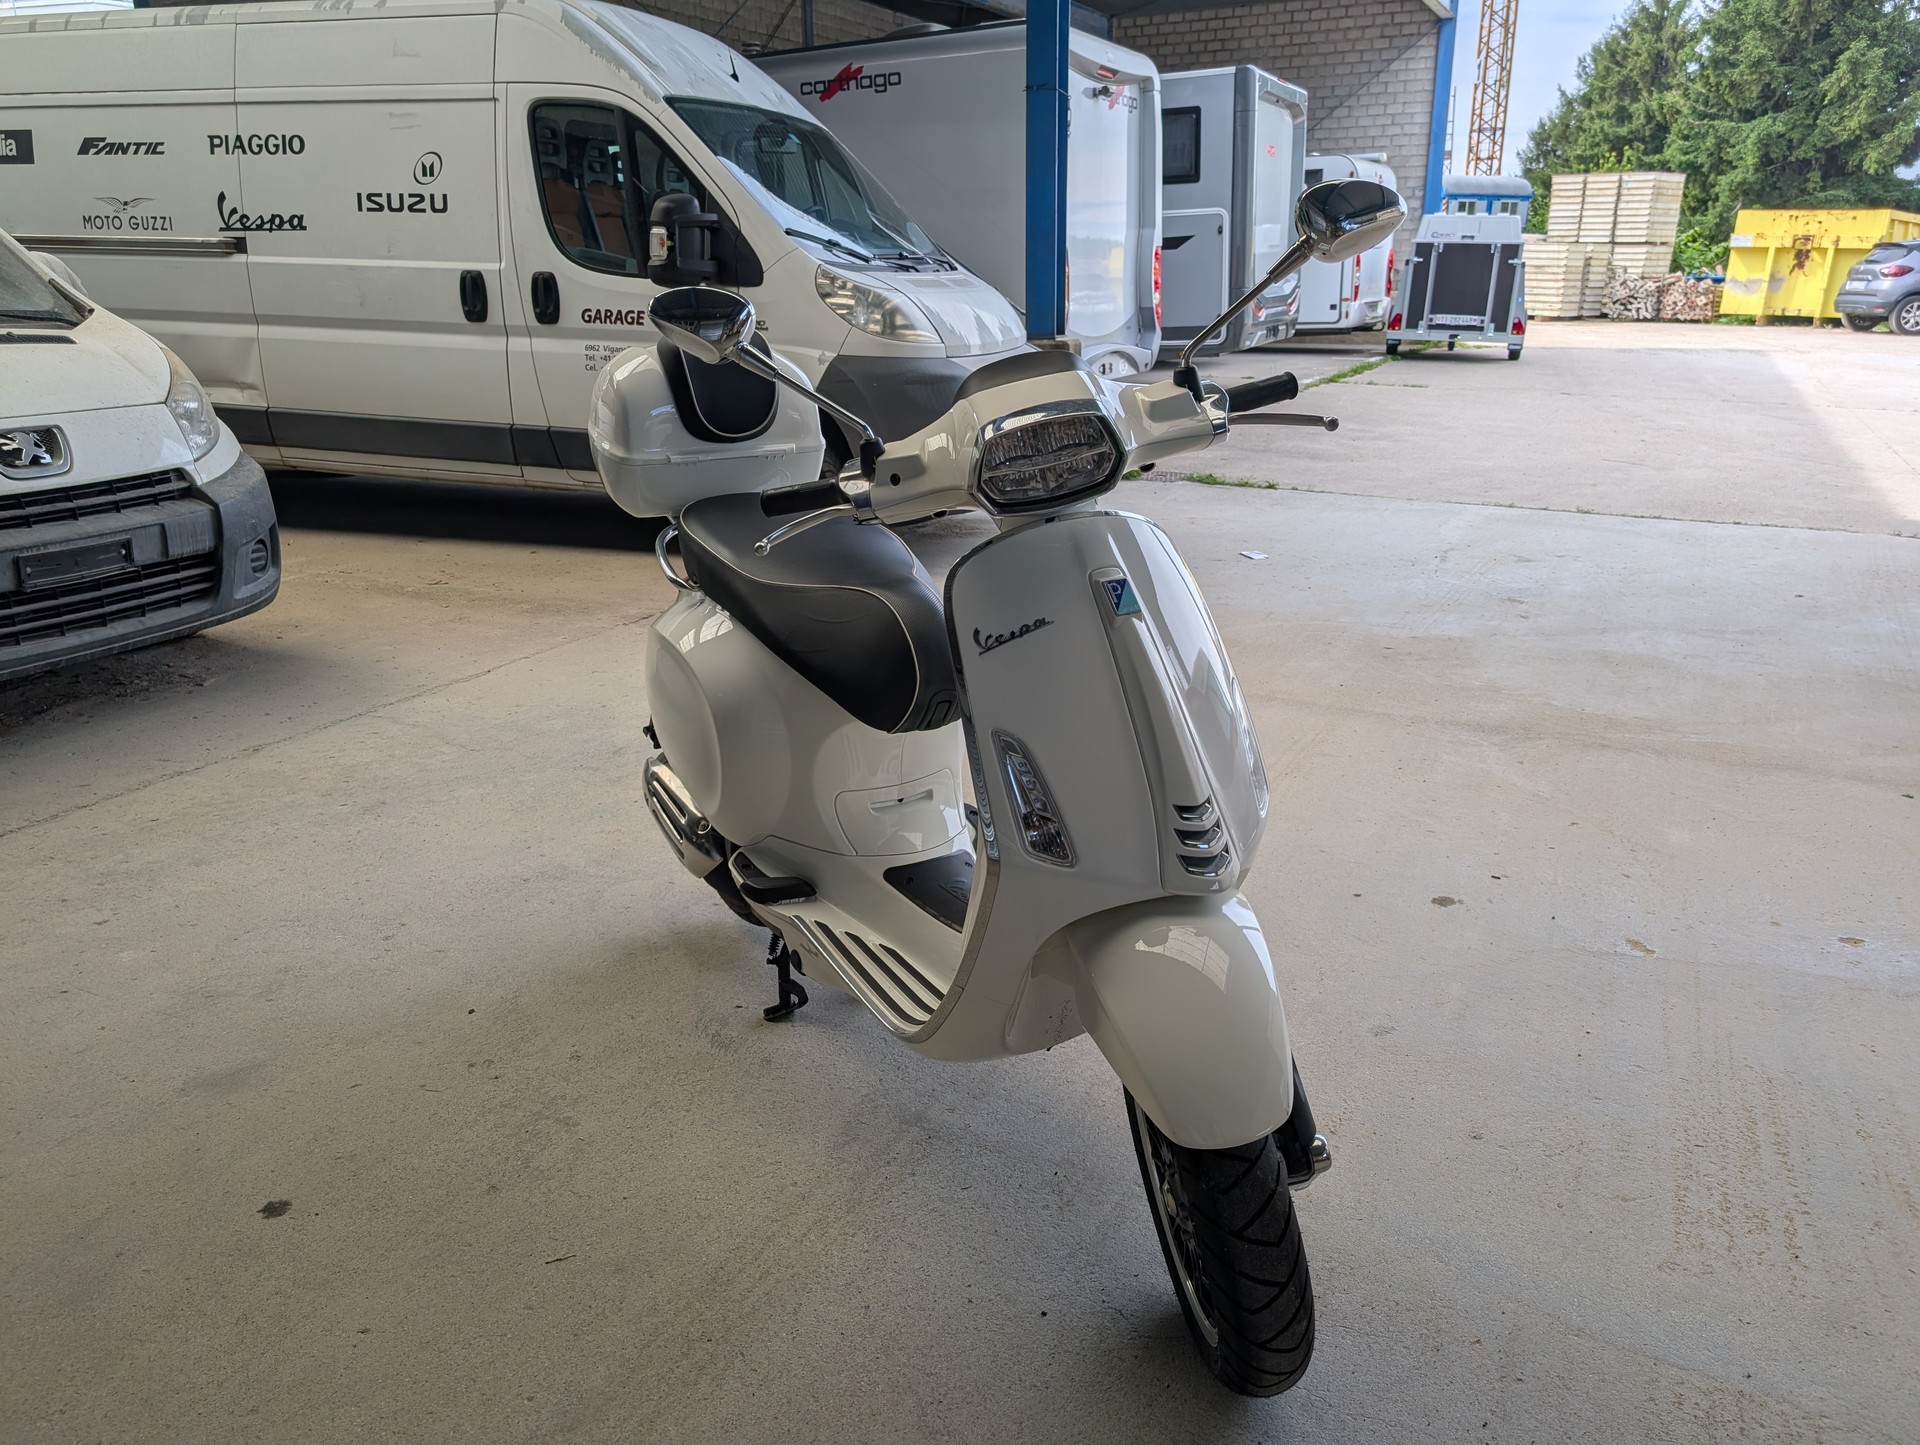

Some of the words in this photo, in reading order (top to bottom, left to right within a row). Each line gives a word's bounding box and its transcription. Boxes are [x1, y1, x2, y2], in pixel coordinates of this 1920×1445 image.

[800, 71, 902, 96] carthago
[207, 133, 306, 156] PIAGGIO
[217, 190, 308, 233] Vespa
[356, 192, 449, 214] ISUZU
[82, 214, 124, 232] MOTO
[128, 214, 174, 232] GUZZI
[580, 307, 646, 326] GARAGE
[584, 344, 601, 352] 6962
[584, 354, 598, 362] Tel.
[584, 364, 598, 372] Cel.
[972, 617, 1055, 656] Vespa
